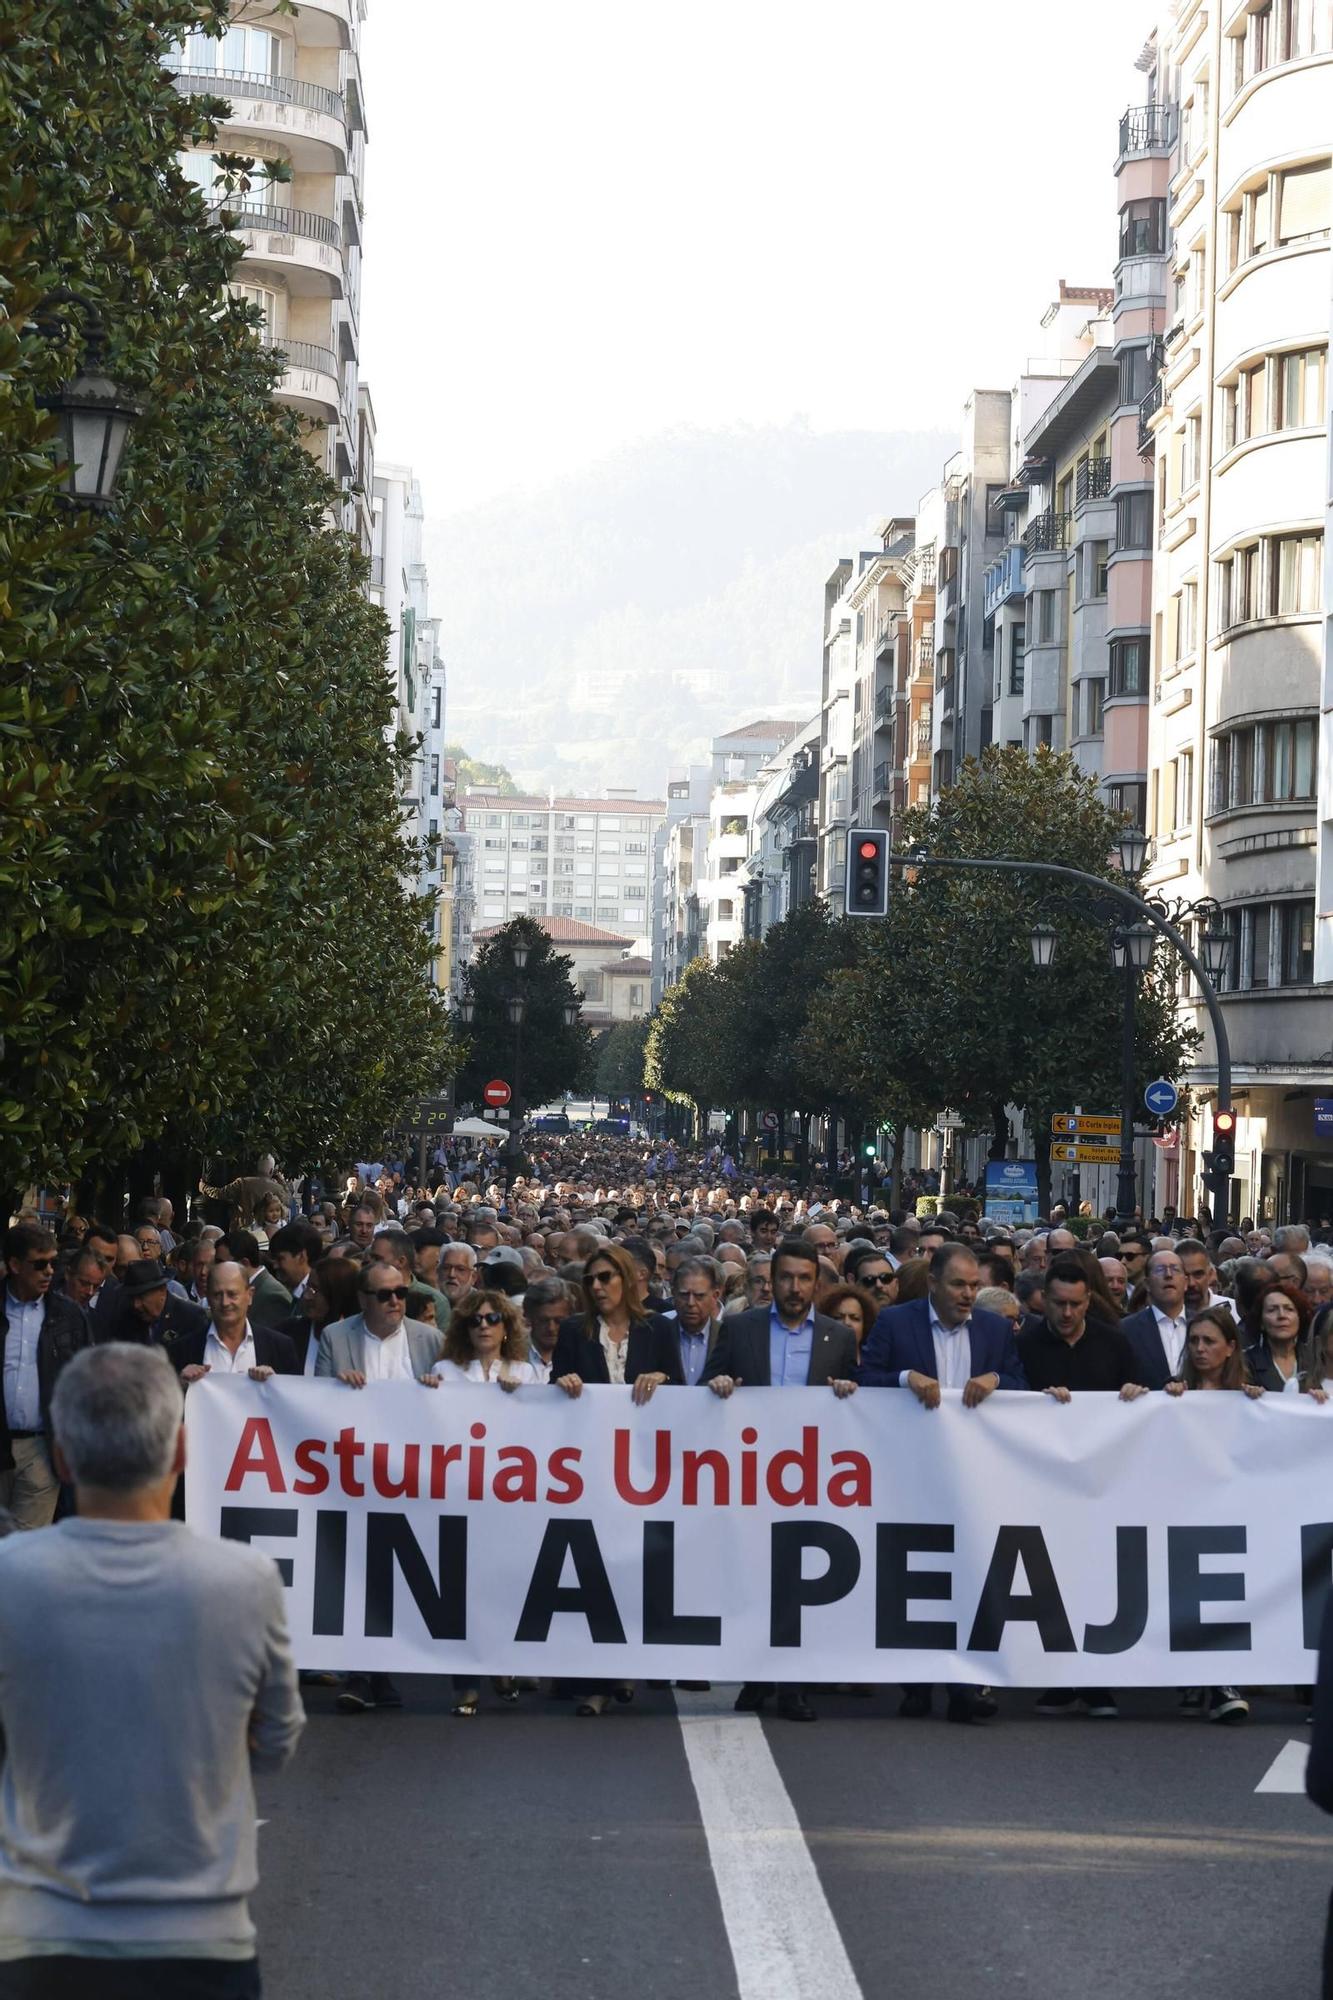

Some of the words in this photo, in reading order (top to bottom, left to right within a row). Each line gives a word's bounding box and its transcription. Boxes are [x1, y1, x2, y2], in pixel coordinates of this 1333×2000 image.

[1069, 1119, 1076, 1129] P
[225, 1417, 584, 1504] Asturias
[614, 1425, 871, 1507] Unida
[513, 1518, 722, 1646] AL
[769, 1520, 1252, 1655] PEAJE
